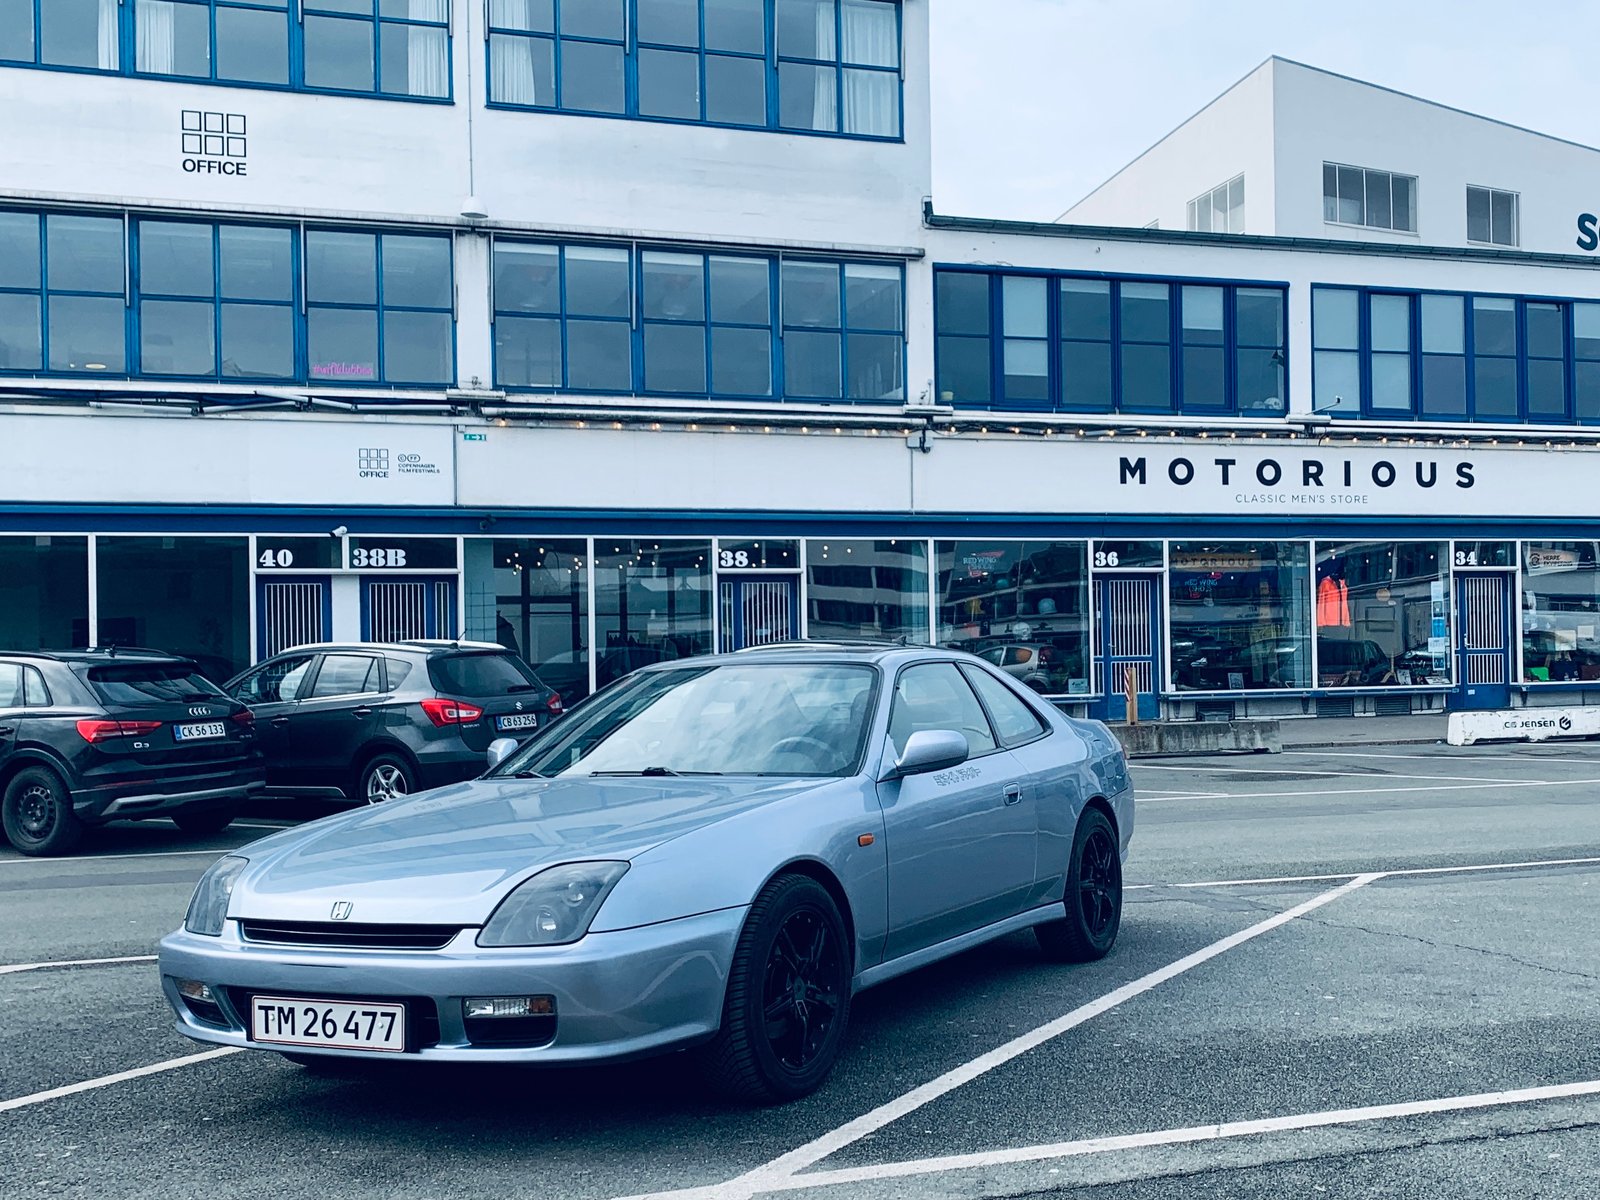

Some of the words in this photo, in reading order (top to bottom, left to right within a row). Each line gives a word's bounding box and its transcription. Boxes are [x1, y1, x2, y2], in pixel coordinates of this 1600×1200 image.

[182, 158, 247, 176] OFFICE
[1576, 213, 1600, 251] S
[359, 470, 389, 478] OFFICE
[1119, 456, 1475, 489] MOTORIOUS
[1235, 493, 1286, 503] CLASSIC
[1291, 494, 1325, 504] MEN'S
[1330, 494, 1369, 504] STORE
[259, 549, 294, 567] 40
[352, 548, 407, 567] 38B
[720, 550, 749, 568] 38
[1094, 551, 1119, 567] 36
[1455, 551, 1478, 566] 34
[502, 717, 512, 727] CB
[513, 716, 523, 726] 63
[523, 715, 536, 725] 256
[1519, 720, 1556, 728] JENSEN
[181, 726, 195, 737] CK
[196, 725, 207, 736] 56
[209, 724, 224, 735] 133
[258, 1005, 295, 1036] TM
[303, 1007, 338, 1039] 26
[343, 1010, 397, 1042] 477
